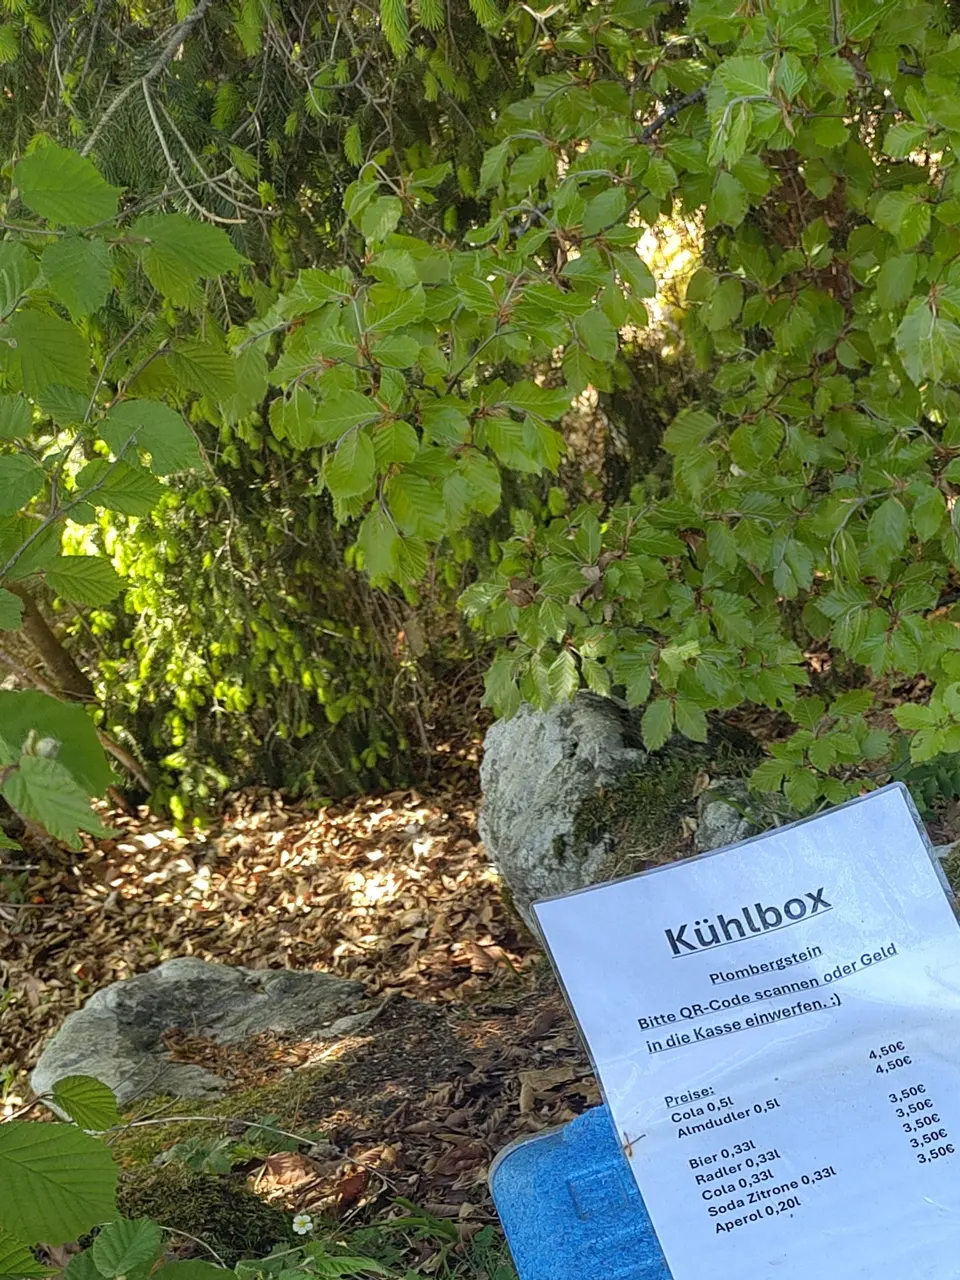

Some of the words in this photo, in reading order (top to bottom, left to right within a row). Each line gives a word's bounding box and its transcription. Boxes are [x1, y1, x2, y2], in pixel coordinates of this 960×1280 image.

[664, 886, 832, 957] Kühlbox
[709, 944, 823, 985] Plombergstein
[637, 1011, 677, 1031] Bitte
[680, 993, 751, 1020] QR-Code
[754, 976, 820, 1001] scannen
[823, 960, 858, 983] oder
[860, 943, 898, 966] Geld
[646, 1039, 663, 1054] in
[666, 1030, 691, 1049] die
[694, 1018, 742, 1041] Kasse
[745, 995, 827, 1027] einwerfen.
[664, 1085, 715, 1109] Preise:
[671, 1106, 705, 1124] Cola
[707, 1095, 734, 1115] 0,5l
[868, 1040, 906, 1061] 4,50€
[677, 1109, 751, 1140] Almdudler
[753, 1098, 781, 1117] 0,5l
[875, 1055, 913, 1076] 4,50€
[688, 1153, 718, 1170] Bier
[720, 1139, 756, 1161] 0,33l
[888, 1083, 927, 1105] 3,50€
[695, 1162, 743, 1186] Radler
[745, 1148, 781, 1170] 0,33l
[895, 1098, 934, 1119] 3,50€
[701, 1184, 736, 1201] Cola
[738, 1168, 774, 1191] 0,33l
[902, 1112, 941, 1134] 3,50€
[708, 1198, 745, 1217] Soda
[746, 1179, 799, 1206] Zitrone
[801, 1165, 837, 1188] 0,33l
[909, 1127, 948, 1149] 3,50€
[715, 1208, 763, 1234] Aperol
[764, 1195, 802, 1218] 0,20l
[916, 1142, 956, 1165] 3,50€
